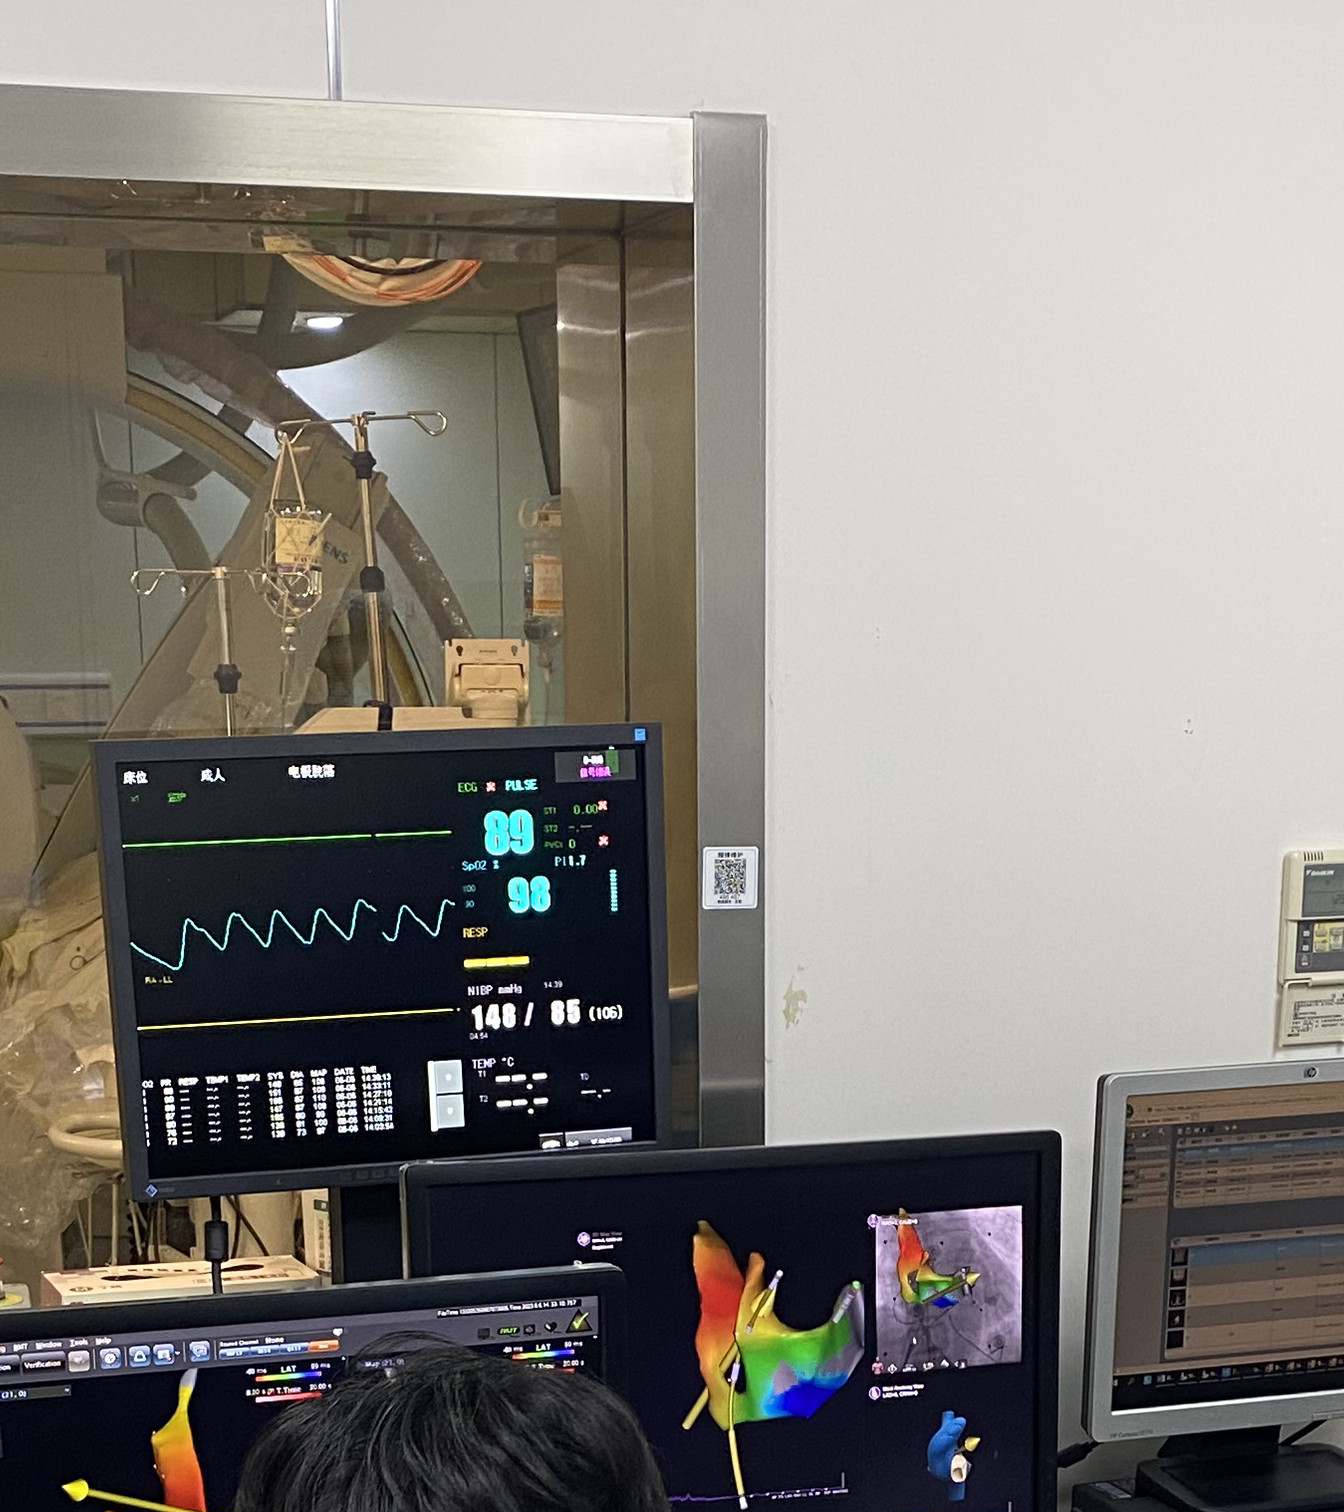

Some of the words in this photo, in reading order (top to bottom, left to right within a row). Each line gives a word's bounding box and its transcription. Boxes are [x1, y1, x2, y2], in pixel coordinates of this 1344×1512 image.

[200, 768, 226, 782] 成人
[458, 782, 478, 793] ECG
[505, 779, 538, 791] PULSE
[573, 804, 598, 815] 0.00
[483, 809, 535, 856] 89
[507, 875, 552, 914] 98
[463, 927, 489, 939] RESP
[467, 985, 493, 996] NIBP
[471, 1002, 516, 1031] 148
[550, 998, 581, 1026] 85
[588, 1004, 623, 1022] (106)
[472, 1058, 496, 1069] TEMP
[310, 1068, 328, 1078] MAP
[334, 1067, 355, 1077] DATE
[24, 1359, 61, 1369] Verification
